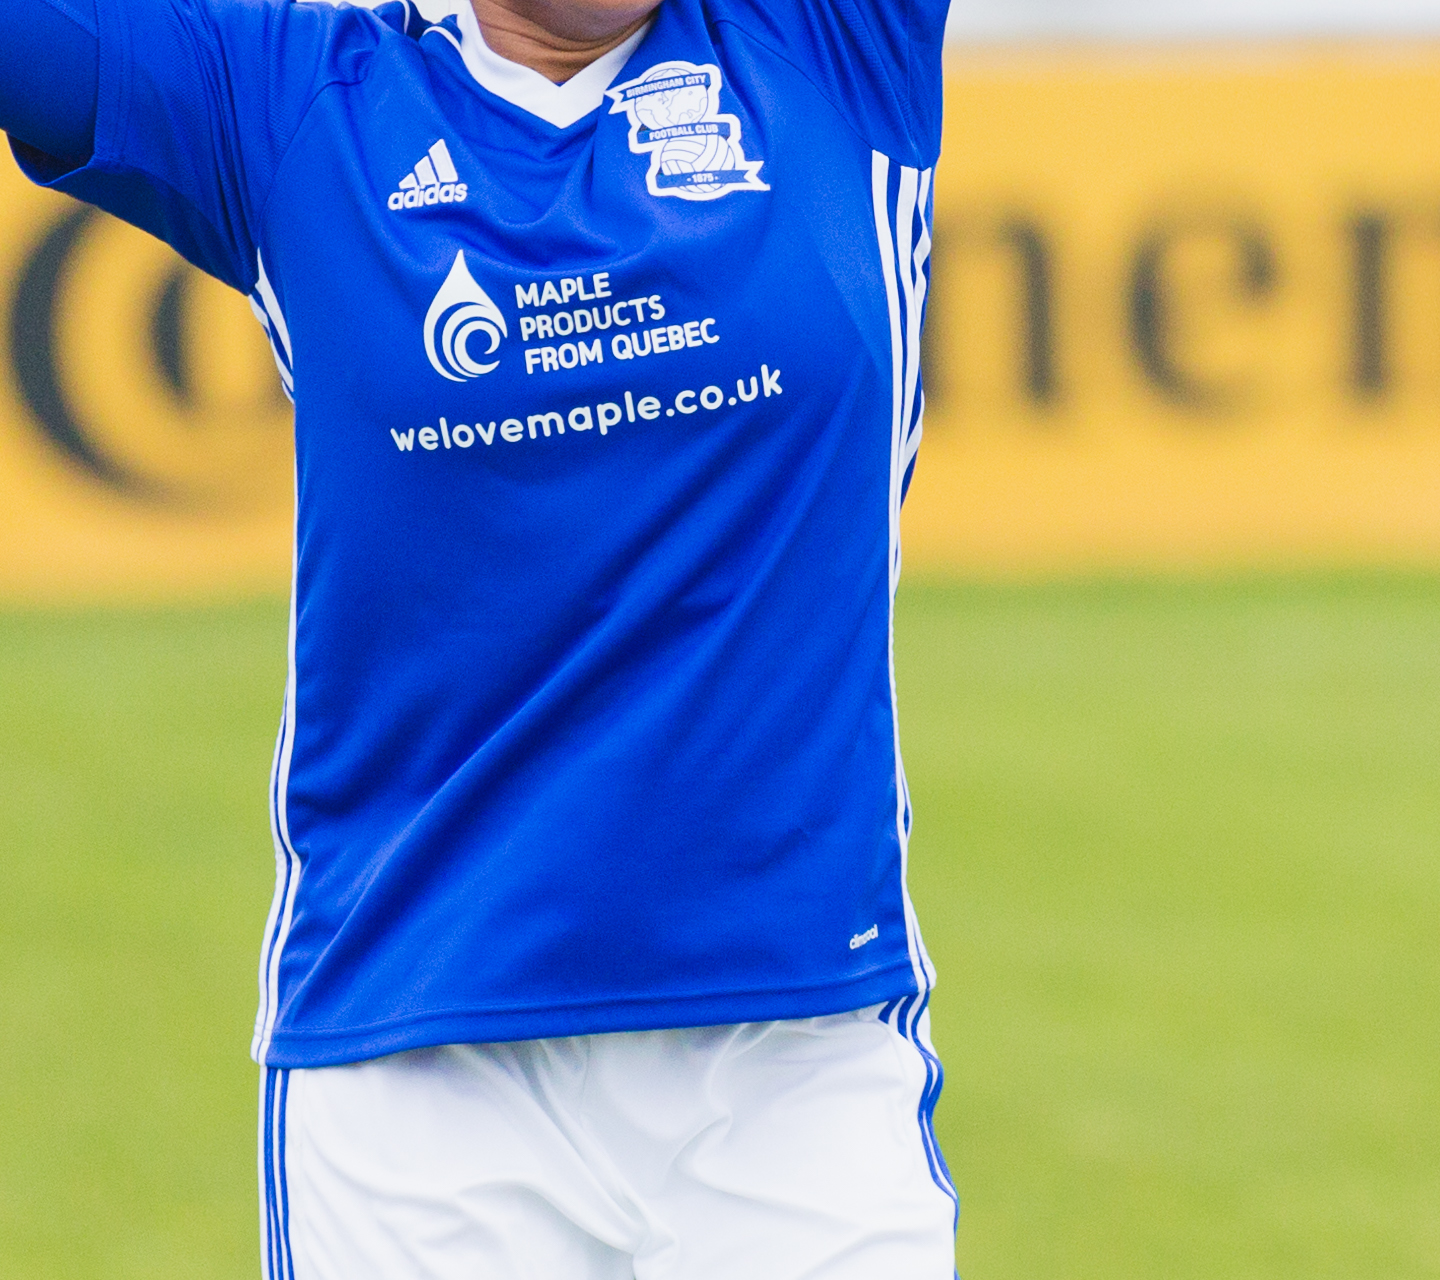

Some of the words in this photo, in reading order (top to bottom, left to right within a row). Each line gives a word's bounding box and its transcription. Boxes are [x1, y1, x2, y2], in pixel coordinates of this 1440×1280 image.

[626, 78, 684, 97] BIRMINGHAM
[685, 75, 706, 85] CITY
[649, 126, 694, 140] FOOTBALL
[695, 124, 718, 134] CLUB
[692, 173, 713, 183] 1875
[387, 180, 468, 211] adidas
[515, 272, 612, 310] MAPLE
[519, 294, 666, 341] PRODUCTS
[525, 337, 604, 375] FROM
[610, 318, 720, 360] QUEBEC
[389, 364, 783, 452] welovemaple.co.uk
